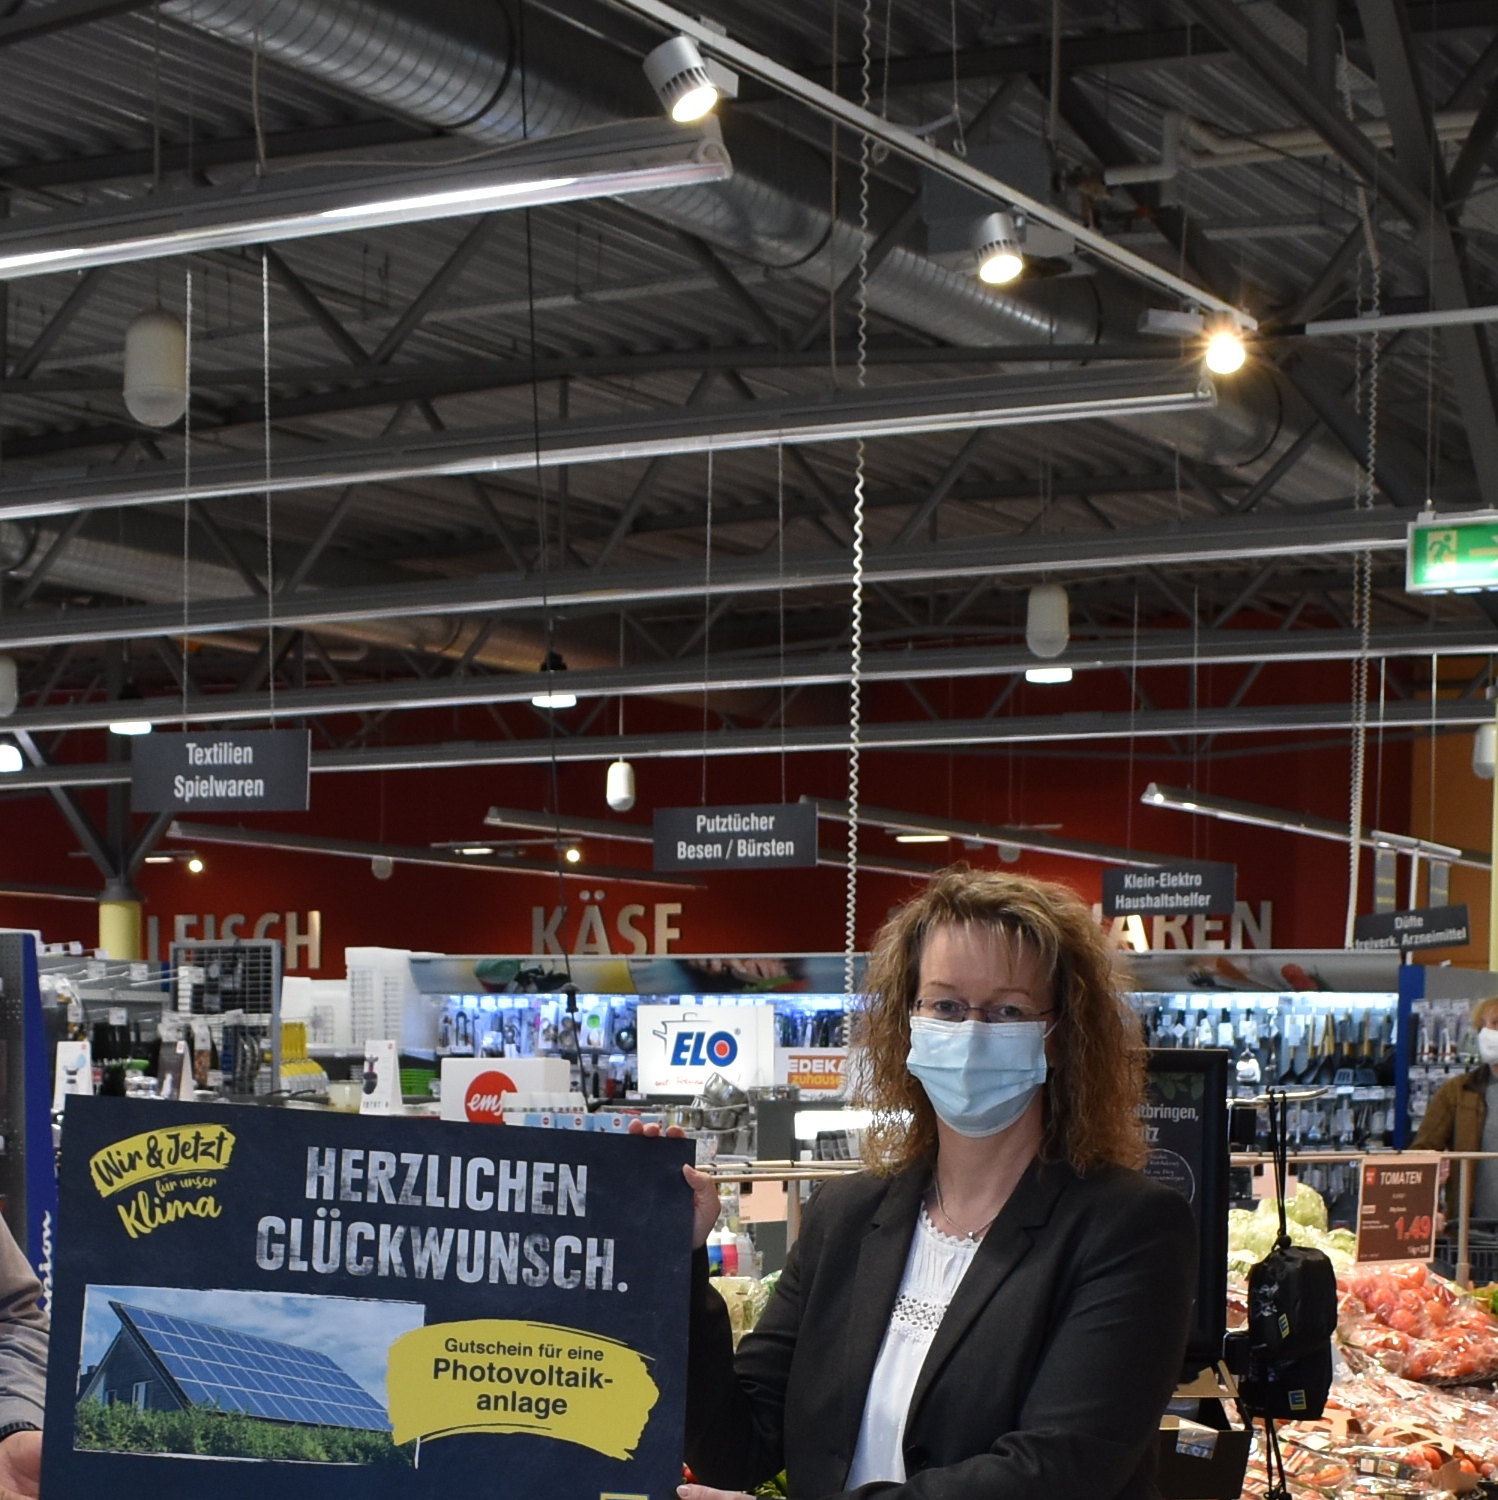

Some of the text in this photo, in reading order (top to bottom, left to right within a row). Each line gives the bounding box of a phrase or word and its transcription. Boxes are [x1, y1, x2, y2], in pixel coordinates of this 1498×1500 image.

[186, 742, 253, 766] Textilien
[174, 774, 264, 801] Spielwaren
[696, 811, 775, 834] Putztücher
[676, 839, 722, 860] Besen
[737, 836, 795, 859] Bürsten
[1124, 872, 1202, 889] Klein-Elektro
[1115, 892, 1211, 910] Haushaltshelfer
[1093, 900, 1272, 952] AREN
[1402, 928, 1466, 945] Arzneimittel
[670, 1030, 738, 1067] ELO
[94, 1131, 228, 1187] Wir & Jetzt
[155, 1176, 217, 1198] für unser
[305, 1146, 588, 1217] HERZLICHEN
[1380, 1171, 1423, 1185] TOMATEN
[117, 1190, 222, 1239] Klima
[256, 1207, 628, 1292] GLÜCKWUNSCH.
[445, 1338, 604, 1361] Gutschein für eine
[433, 1357, 613, 1389] Photovoltaik-
[477, 1391, 568, 1419] anlage
